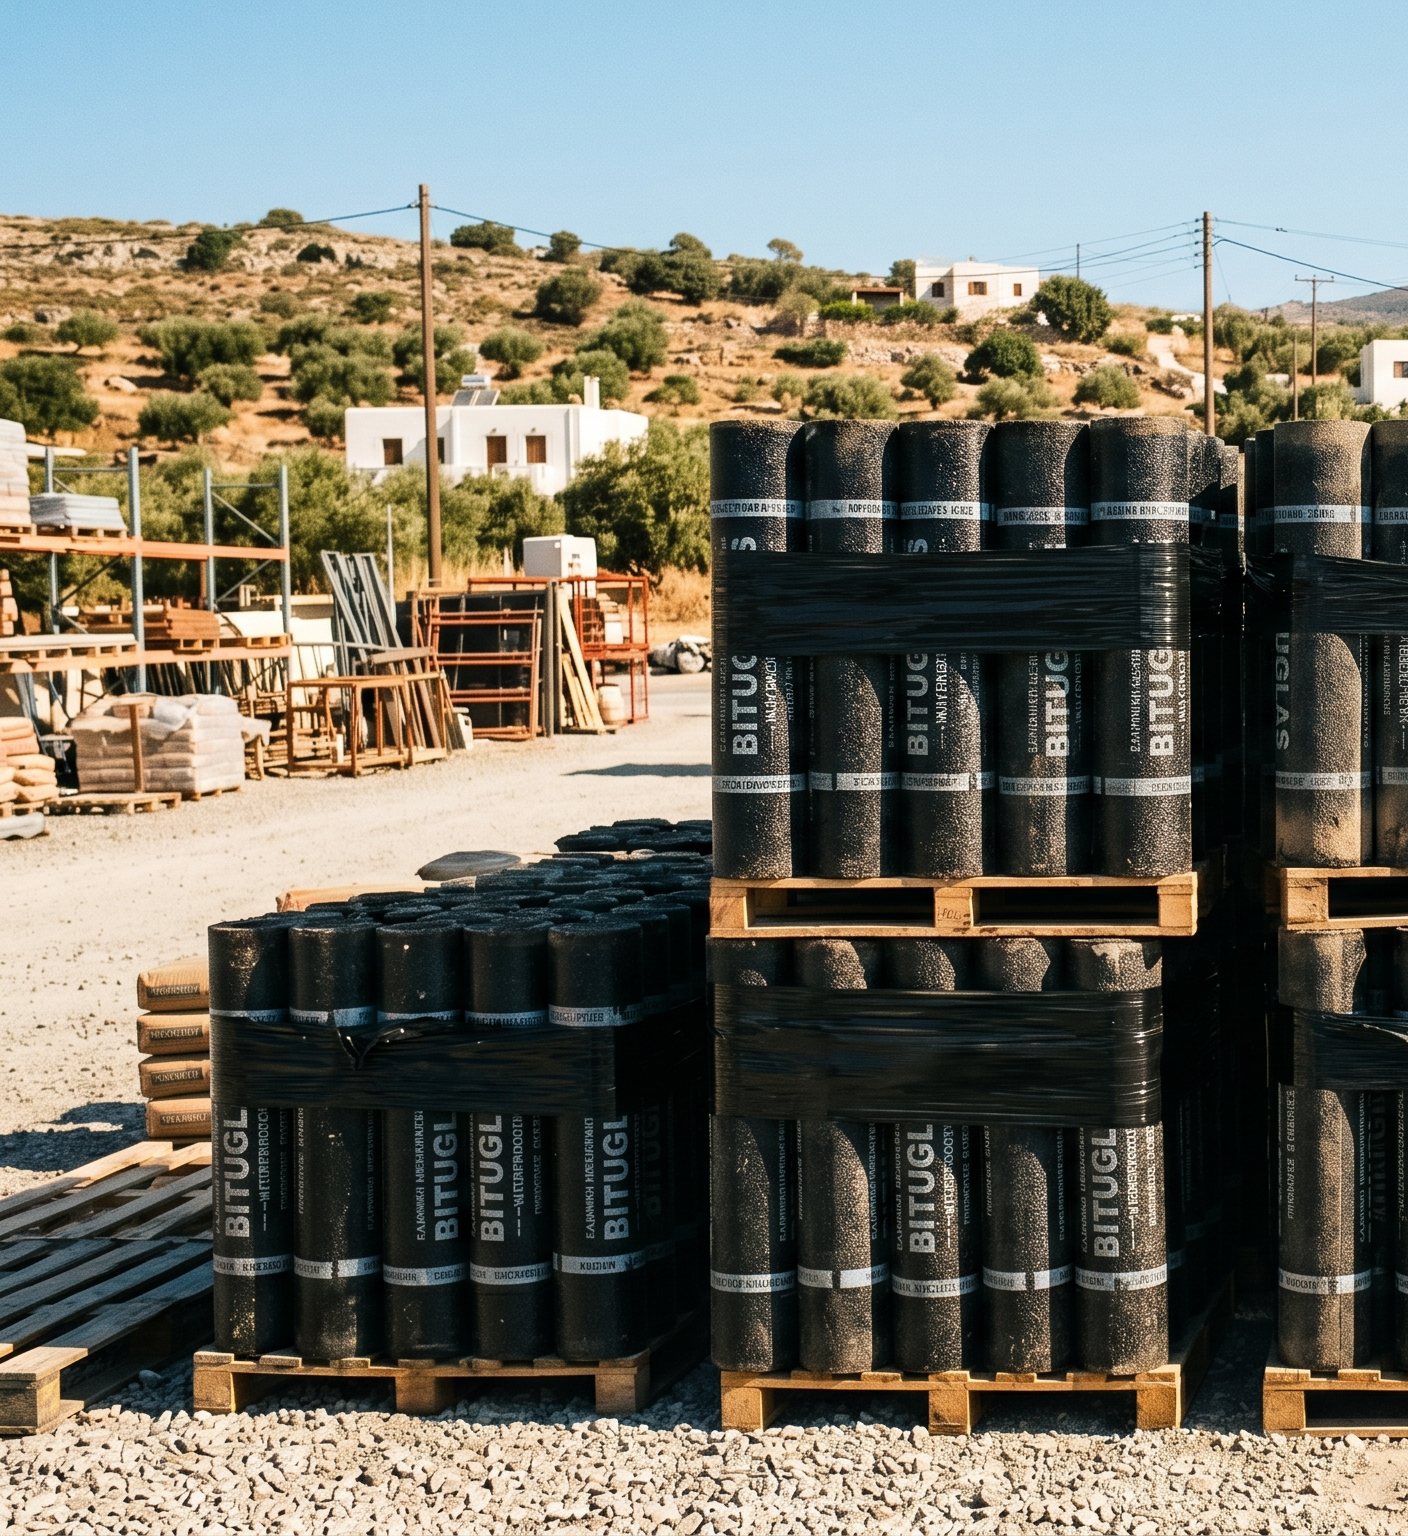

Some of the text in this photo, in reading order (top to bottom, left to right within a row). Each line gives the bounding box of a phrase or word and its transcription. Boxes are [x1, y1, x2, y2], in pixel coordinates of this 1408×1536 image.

[1045, 650, 1070, 757] BITUG
[1148, 650, 1175, 757] BITUG
[1275, 632, 1290, 750] UGLAS
[223, 1107, 250, 1238] BITUGL
[433, 1112, 459, 1241] BITUGL
[478, 1115, 504, 1242] BITUGL
[602, 1115, 629, 1240] BITUGL
[906, 1124, 936, 1253] BITUGL
[1091, 1129, 1120, 1258] BITUGL
